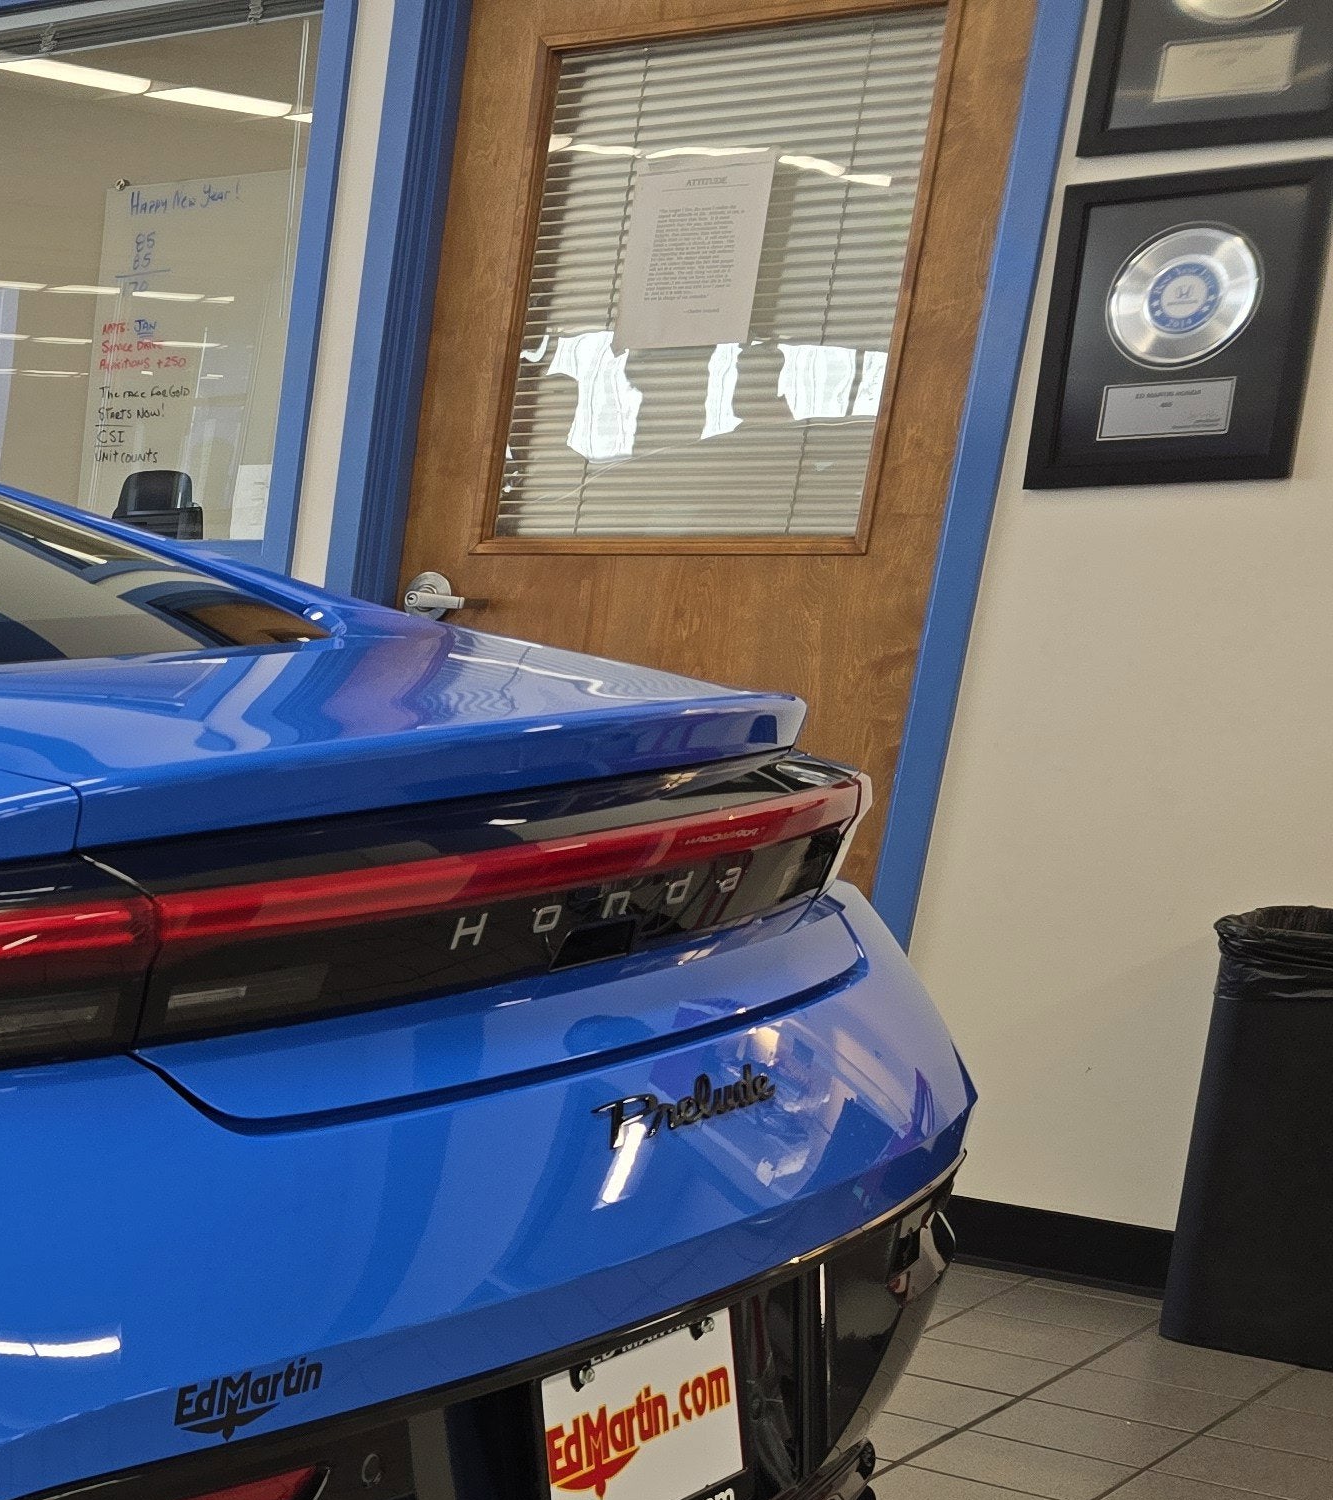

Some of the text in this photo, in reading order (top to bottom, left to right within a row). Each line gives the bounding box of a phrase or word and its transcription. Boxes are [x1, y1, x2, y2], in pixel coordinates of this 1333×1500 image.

[96, 430, 126, 444] CSI
[590, 1063, 777, 1150] Prelude
[173, 1356, 324, 1432] EdMartin
[544, 1364, 732, 1490] EdMartin.com
